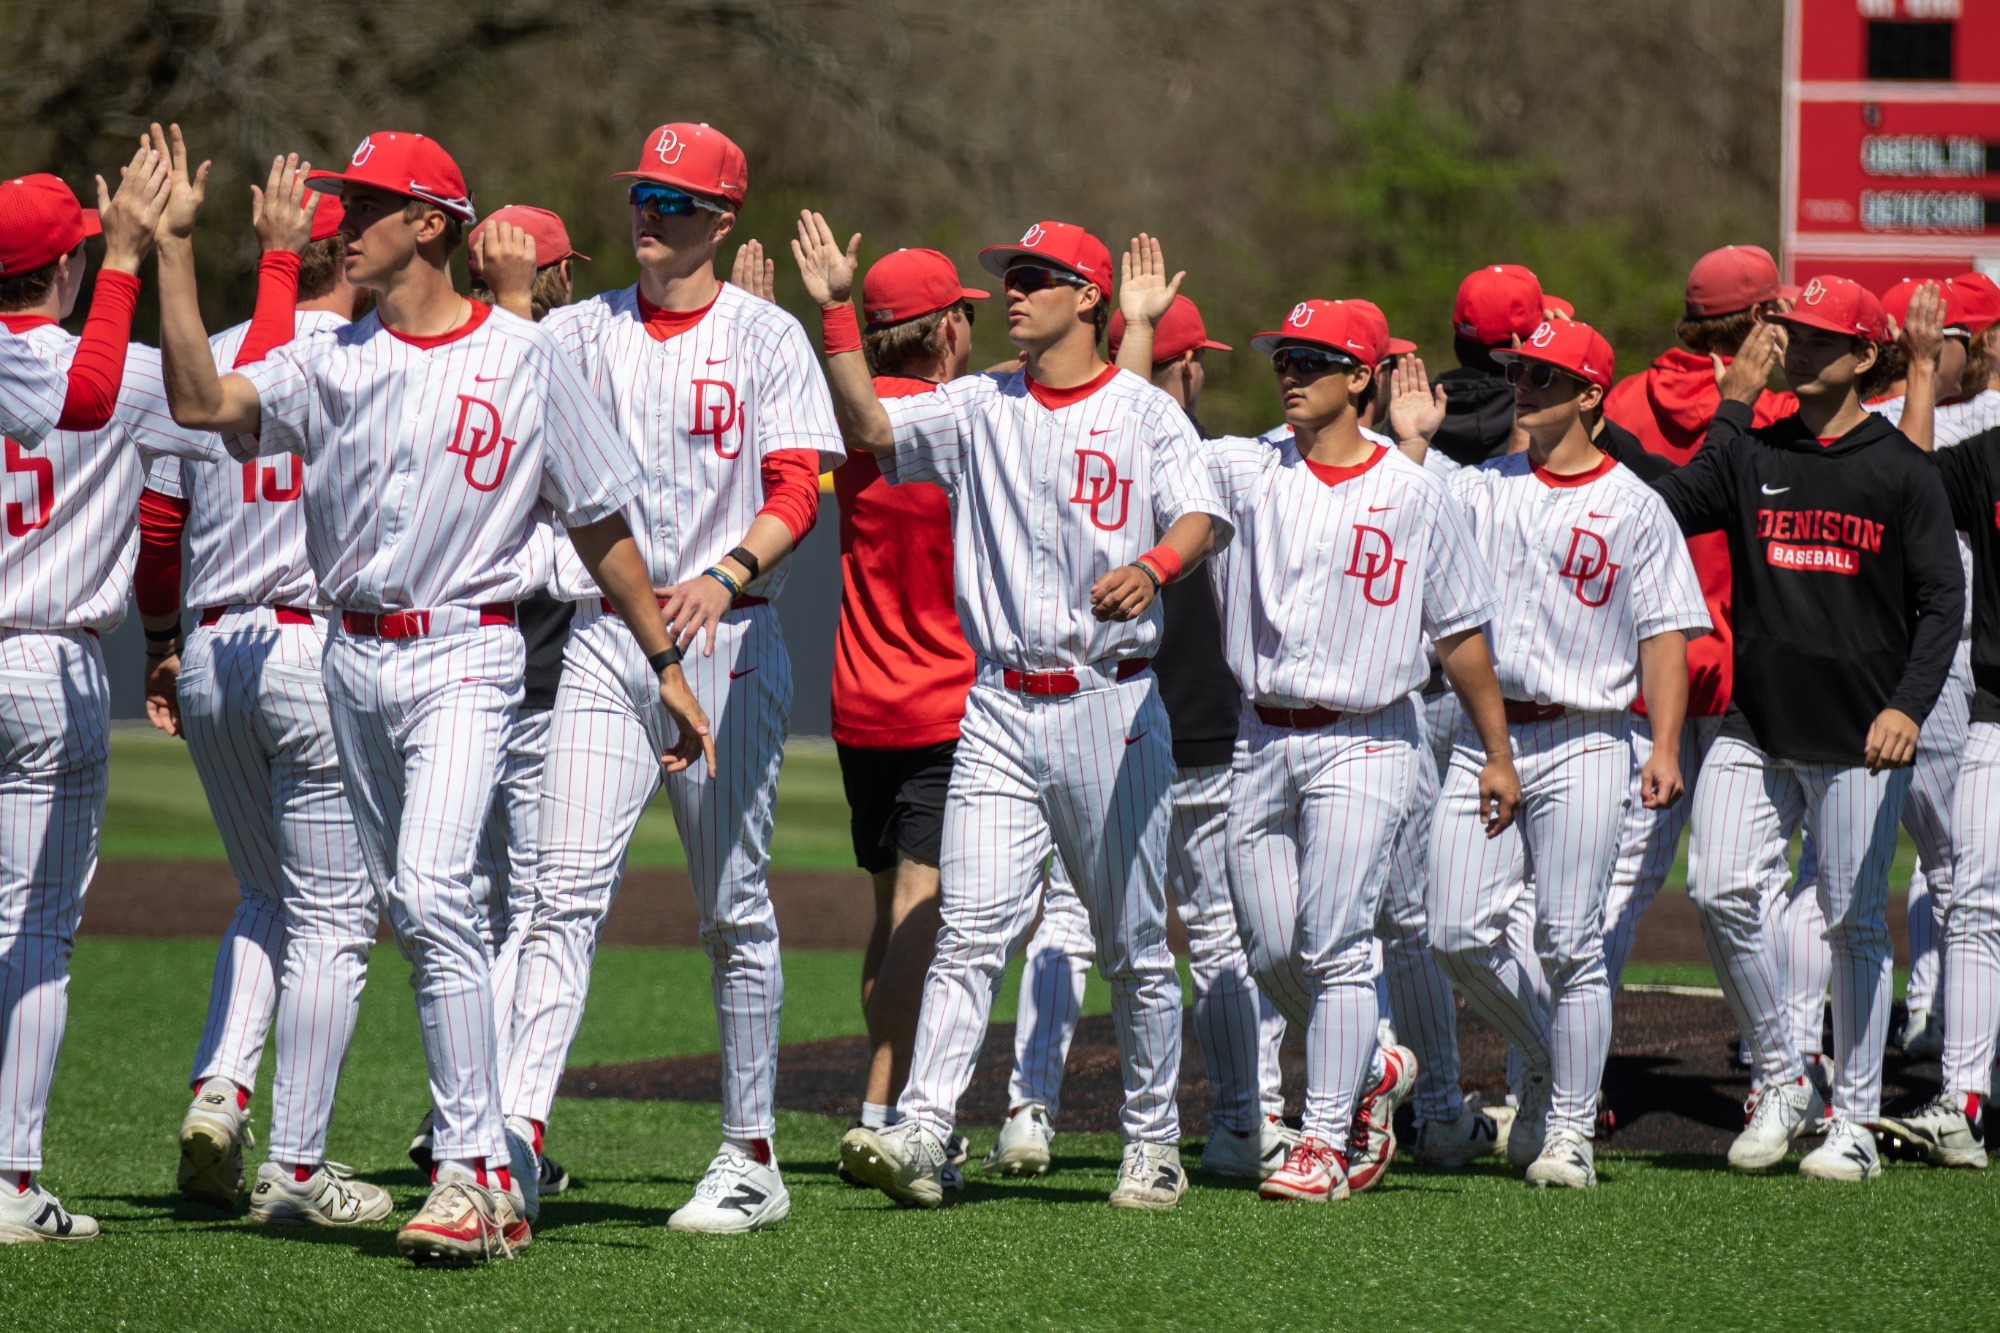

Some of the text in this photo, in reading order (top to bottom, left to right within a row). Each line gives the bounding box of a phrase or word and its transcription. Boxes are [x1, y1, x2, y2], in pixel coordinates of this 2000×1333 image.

[654, 129, 686, 165] DU
[1020, 223, 1046, 247] DU
[1803, 278, 1828, 306] DU
[1288, 302, 1314, 328] DU
[1530, 321, 1556, 348] DU
[689, 378, 746, 460] DU
[446, 393, 517, 492] DU
[1069, 448, 1134, 532] DU
[1756, 508, 1885, 554] DENISON
[1344, 523, 1408, 607] DU
[1558, 527, 1621, 608] DU
[1772, 546, 1854, 570] BASEBALL
